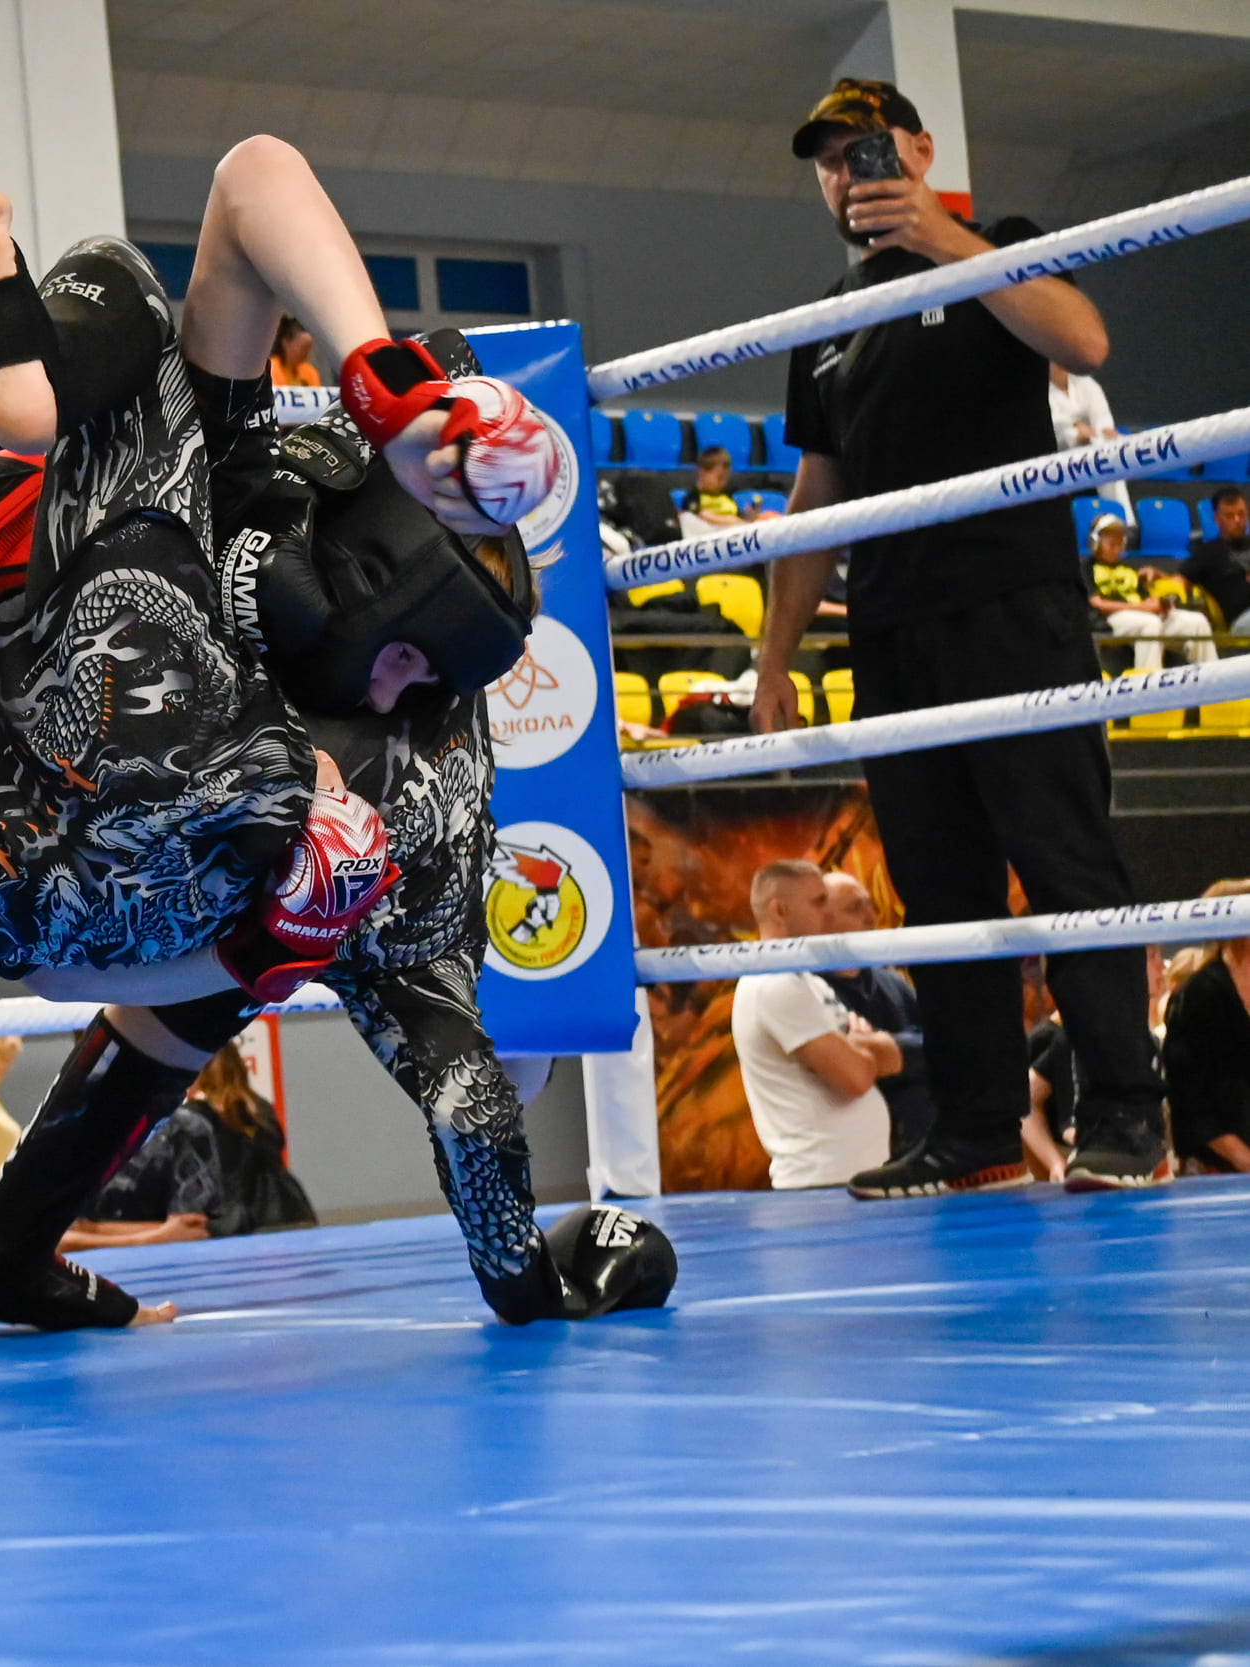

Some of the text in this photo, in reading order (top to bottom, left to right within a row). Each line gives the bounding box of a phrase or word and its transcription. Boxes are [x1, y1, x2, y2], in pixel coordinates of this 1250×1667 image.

[999, 429, 1181, 497] ПРОМЕТЕЙ
[621, 528, 762, 583] ПРОМЕТЕЙ
[333, 856, 383, 874] RDX
[276, 918, 340, 940] IMMAF
